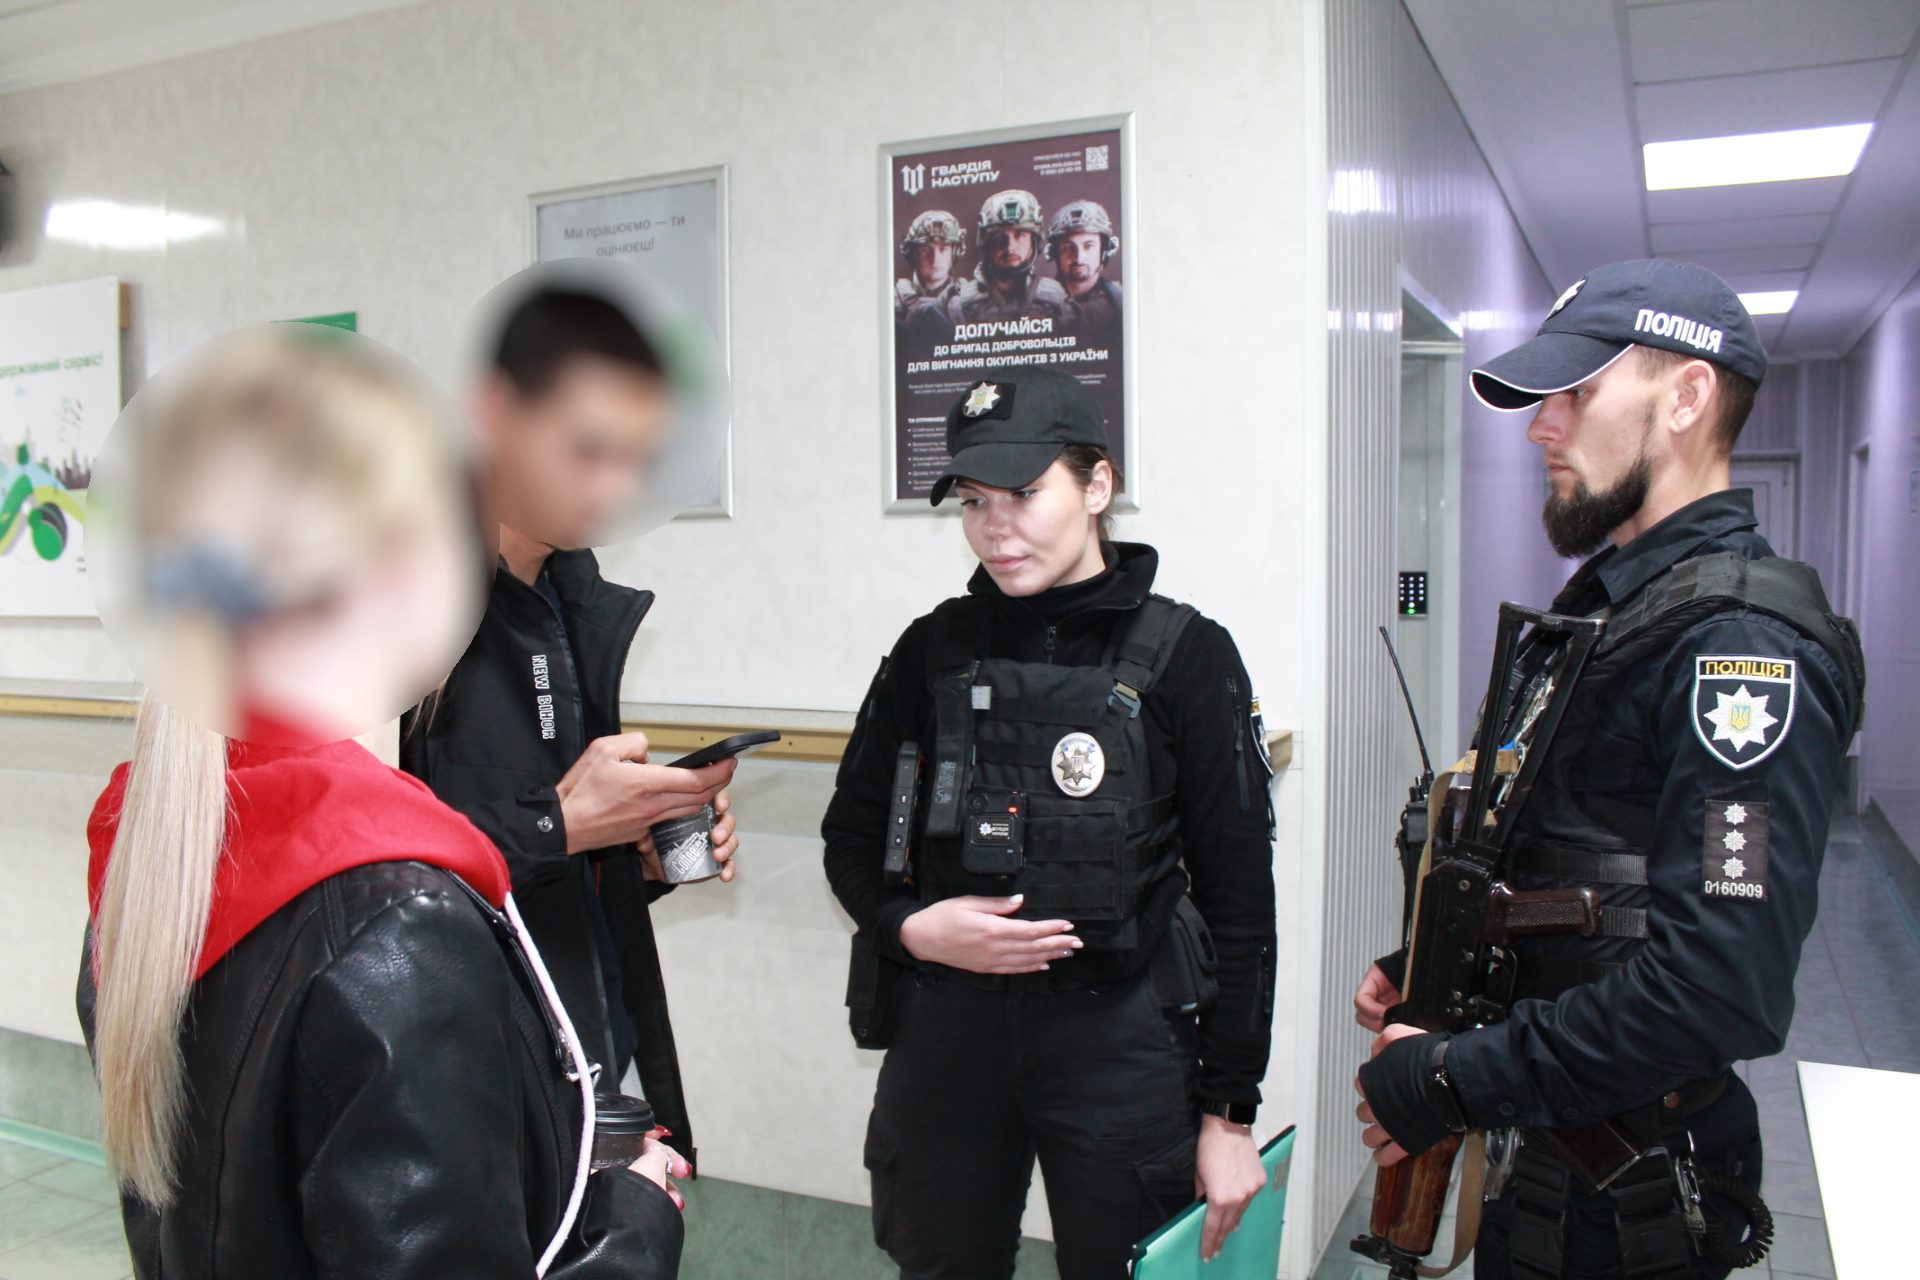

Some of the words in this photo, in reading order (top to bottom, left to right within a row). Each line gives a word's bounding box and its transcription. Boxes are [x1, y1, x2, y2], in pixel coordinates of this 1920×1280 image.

[931, 160, 992, 177] ГВАРДІЯ
[931, 170, 1000, 189] НАСТУПУ
[564, 227, 583, 240] Ми
[586, 220, 651, 239] працюємо
[670, 215, 686, 227] ти
[596, 238, 654, 257] оцінюєш!
[954, 317, 1052, 340] ДОЛУЧАЙСЯ
[1634, 308, 1723, 353] ПОЛІЦІЯ
[933, 345, 949, 357] ДО
[951, 341, 990, 354] БРИГАД
[992, 335, 1077, 352] ДОБРОВОЛЬЦІВ
[907, 361, 930, 374] ДЛЯ
[931, 357, 984, 371] ВИГНАННЯ
[986, 353, 1047, 367] ОКУПАНТІВ
[1049, 354, 1057, 364] З
[1059, 348, 1109, 362] УКРАЇНИ
[532, 654, 550, 689] NEW
[1705, 661, 1786, 679] ПОЛІЦІЯ
[1704, 880, 1763, 899] 0160909
